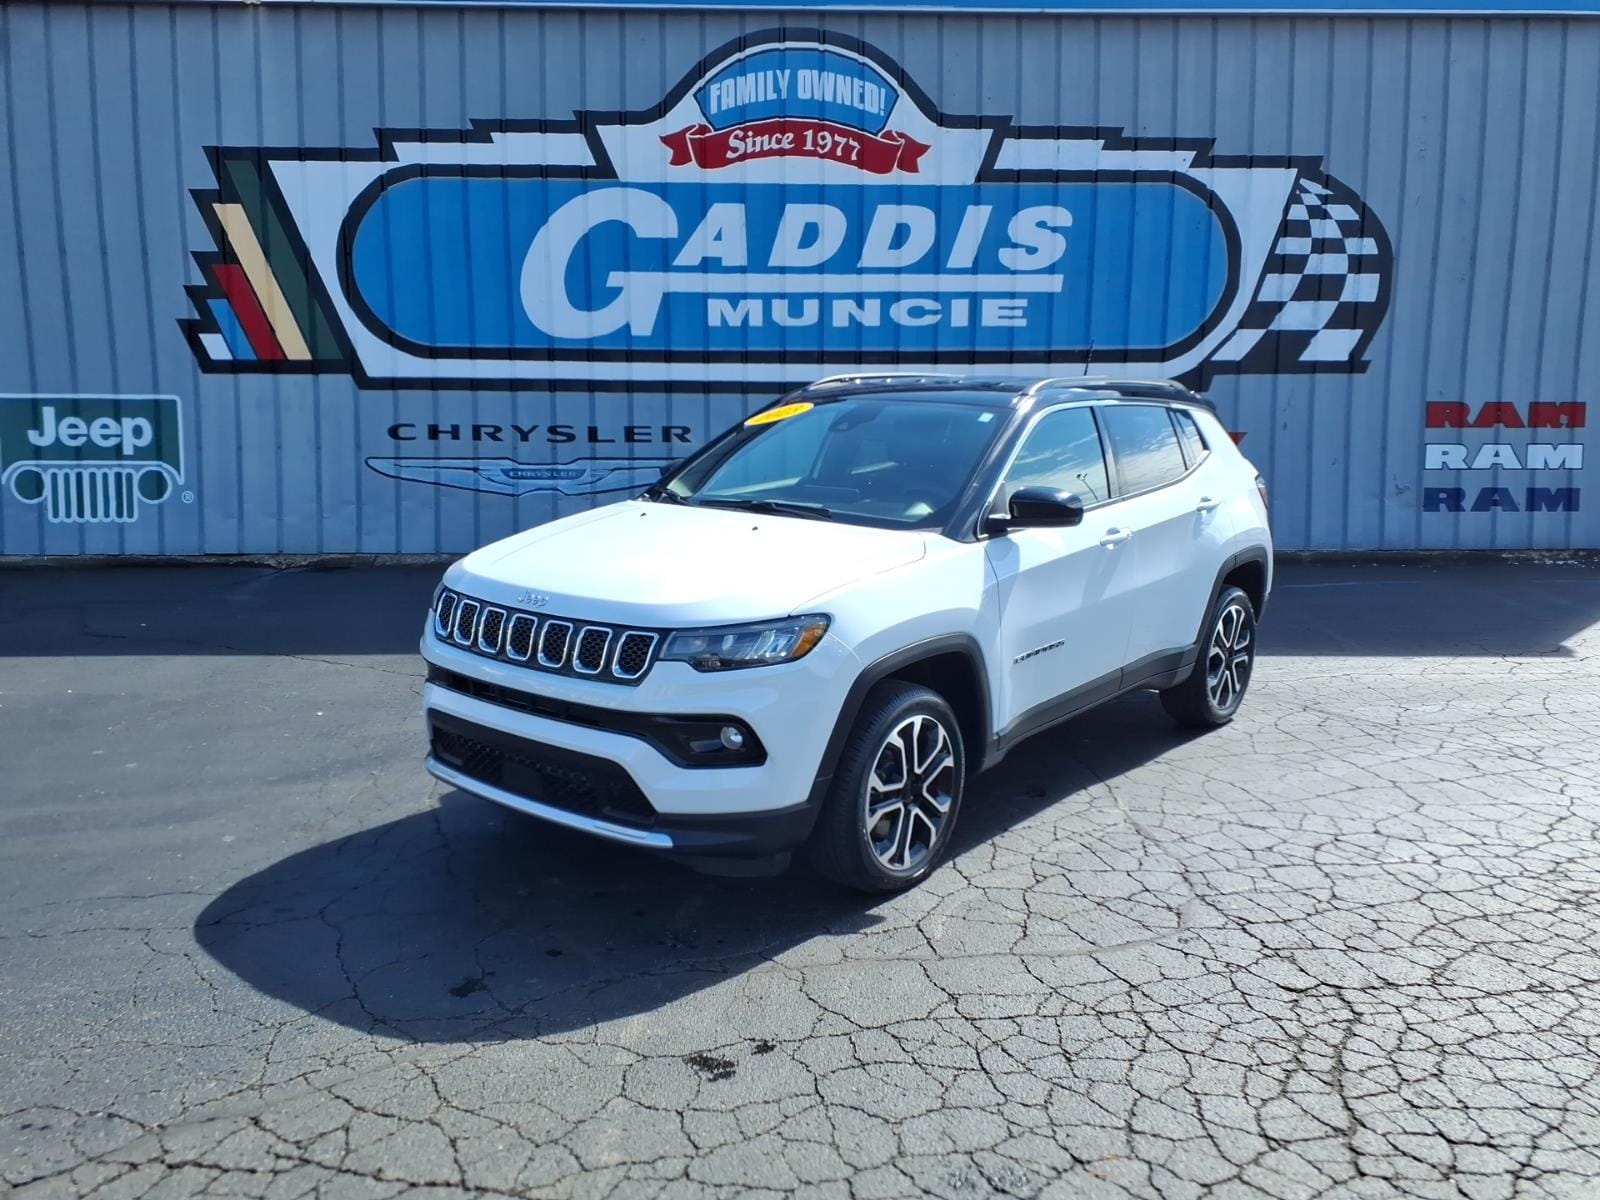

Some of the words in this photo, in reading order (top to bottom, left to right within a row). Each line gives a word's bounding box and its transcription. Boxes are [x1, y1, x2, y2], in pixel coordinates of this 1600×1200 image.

[709, 69, 791, 114] FAMILY
[797, 69, 887, 116] OWNED!
[726, 129, 795, 159] Since
[802, 129, 862, 161] 1977
[519, 187, 1073, 339] GADDIS
[707, 298, 1029, 328] MUNCIE
[1425, 401, 1587, 428] RAM
[27, 406, 153, 455] Jeep
[386, 423, 693, 444] CHRYSLER
[1424, 443, 1584, 470] RAM
[1422, 487, 1581, 512] RAM
